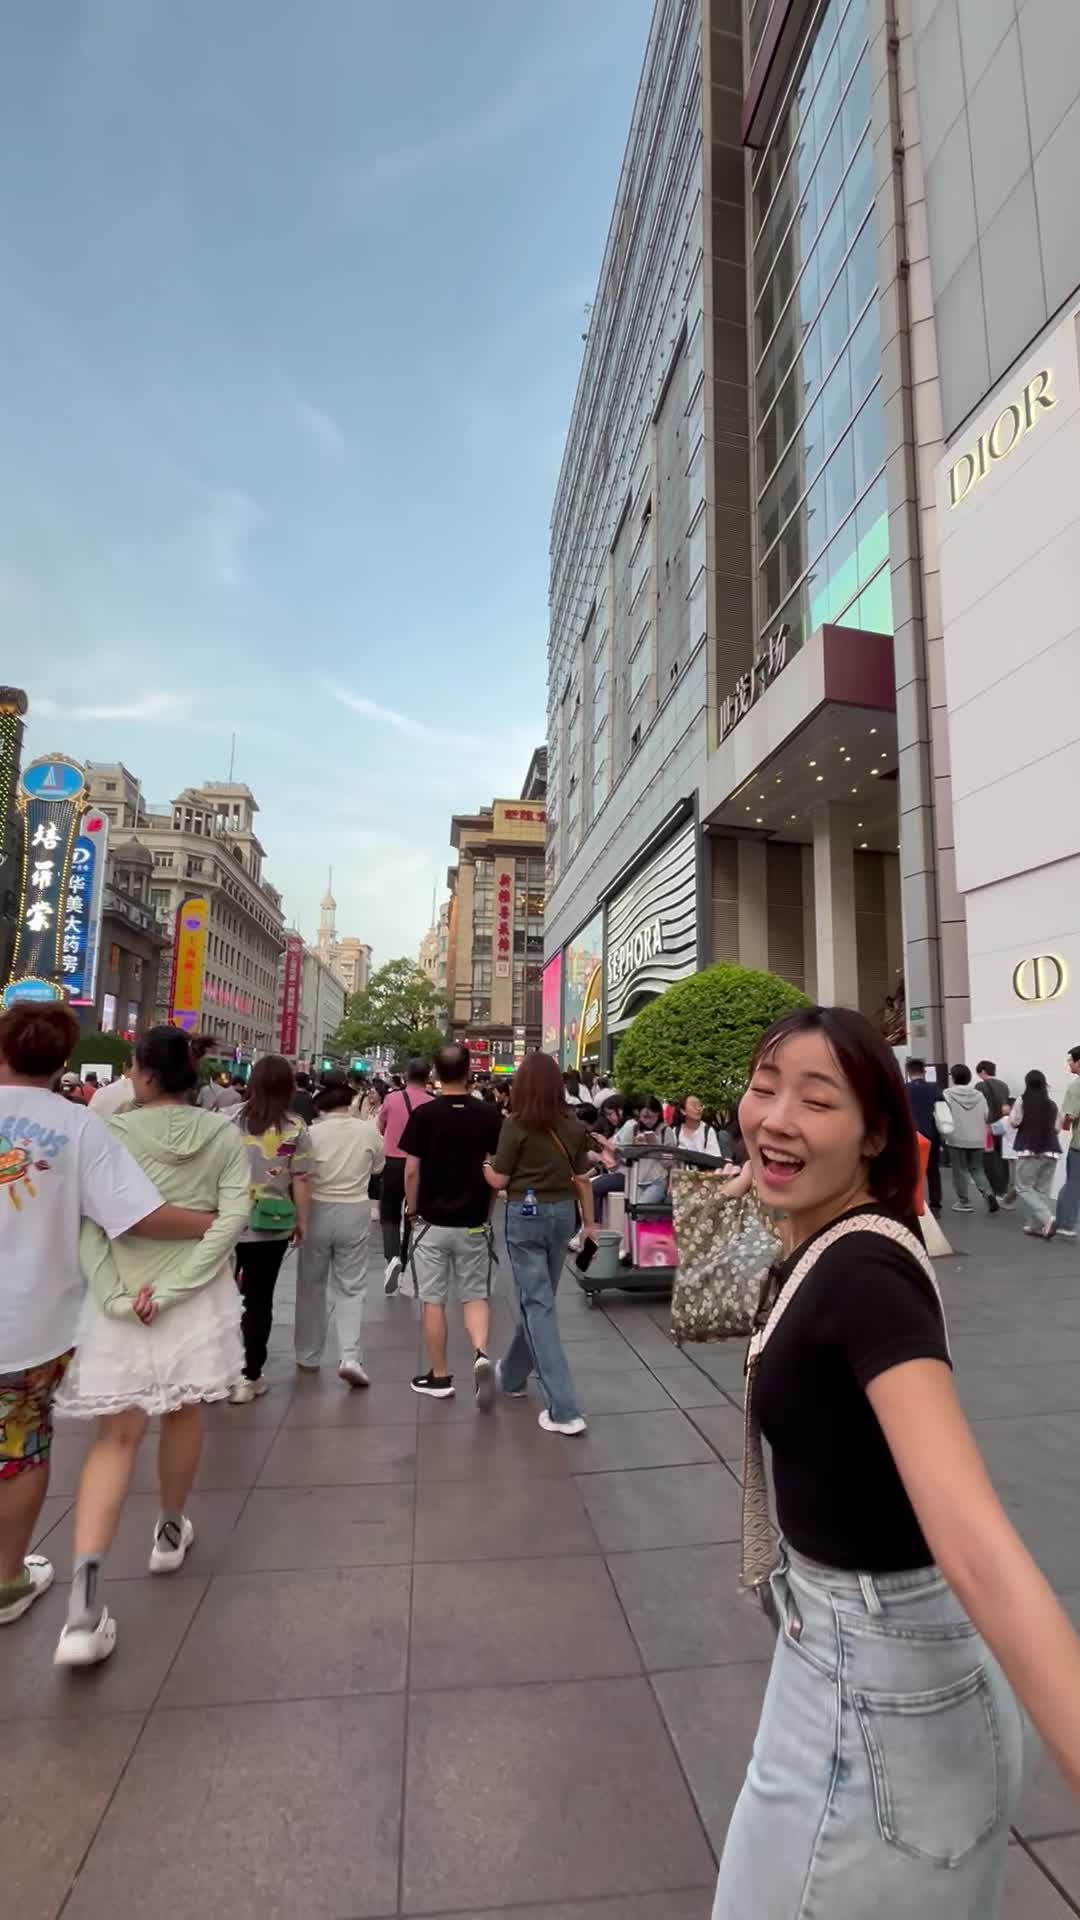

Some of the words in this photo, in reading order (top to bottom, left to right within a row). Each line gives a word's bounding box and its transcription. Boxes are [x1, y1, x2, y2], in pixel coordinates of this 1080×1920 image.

[947, 369, 1057, 508] DIOR
[62, 875, 86, 974] 华美大药房
[608, 918, 663, 985] SEPHORA
